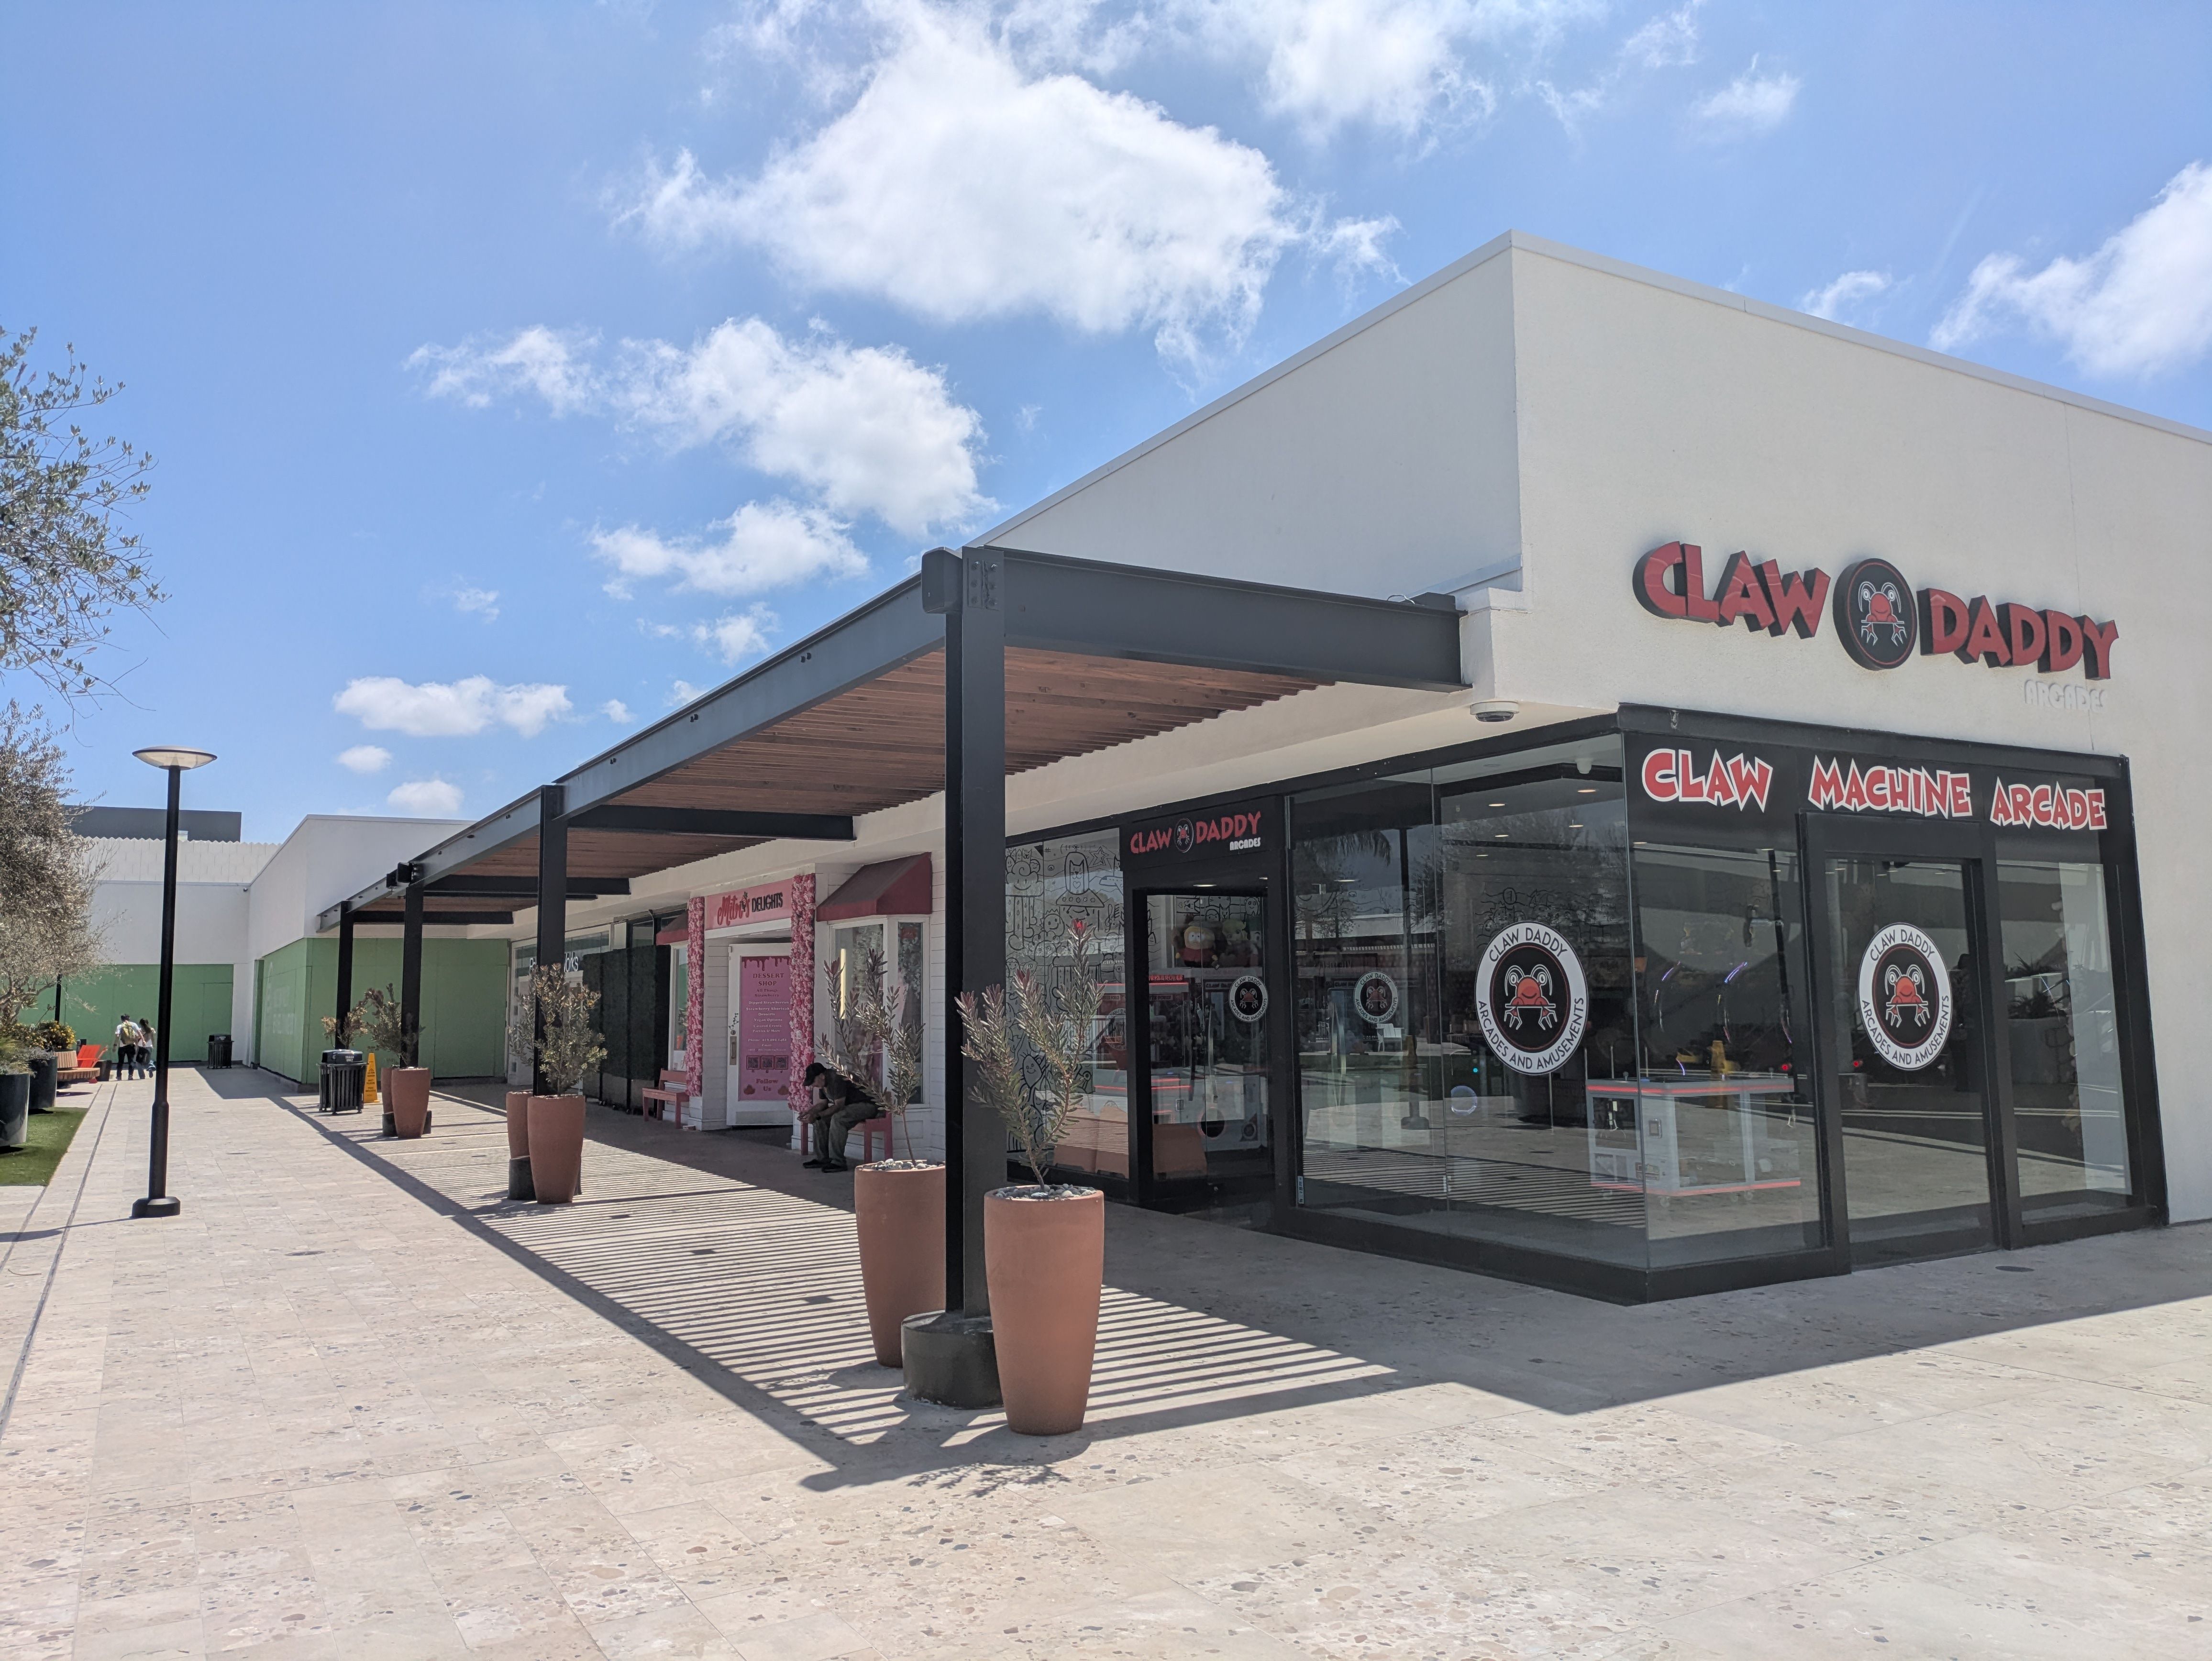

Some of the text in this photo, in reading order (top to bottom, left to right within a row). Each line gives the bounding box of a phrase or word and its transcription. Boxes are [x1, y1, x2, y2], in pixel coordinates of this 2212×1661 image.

[1633, 541, 2119, 679] CLAW DADDY
[1642, 748, 2107, 830] CLAW MACHINE ARCADE
[1130, 811, 1261, 853] CLAW DADDY
[1229, 838, 1261, 851] ARCADES
[752, 892, 783, 912] DELIGHTS
[1489, 928, 1568, 962] CLAW DADDY
[1870, 929, 1935, 961] CLAW DADDY
[1235, 977, 1246, 987] CLAW
[1248, 977, 1262, 986] DADDY
[1360, 973, 1373, 985] CLAW
[1375, 973, 1391, 984] DADDY
[1230, 999, 1241, 1017] ARCADES
[1251, 998, 1267, 1020] AMUSEMENTS
[1355, 998, 1368, 1019] ARCADES
[1379, 997, 1397, 1022] AMUSEMENTS
[1478, 997, 1584, 1070] ARCADES AND AMUSEMENTS
[1862, 995, 1949, 1065] ARCADES AND AMUSEMENTS
